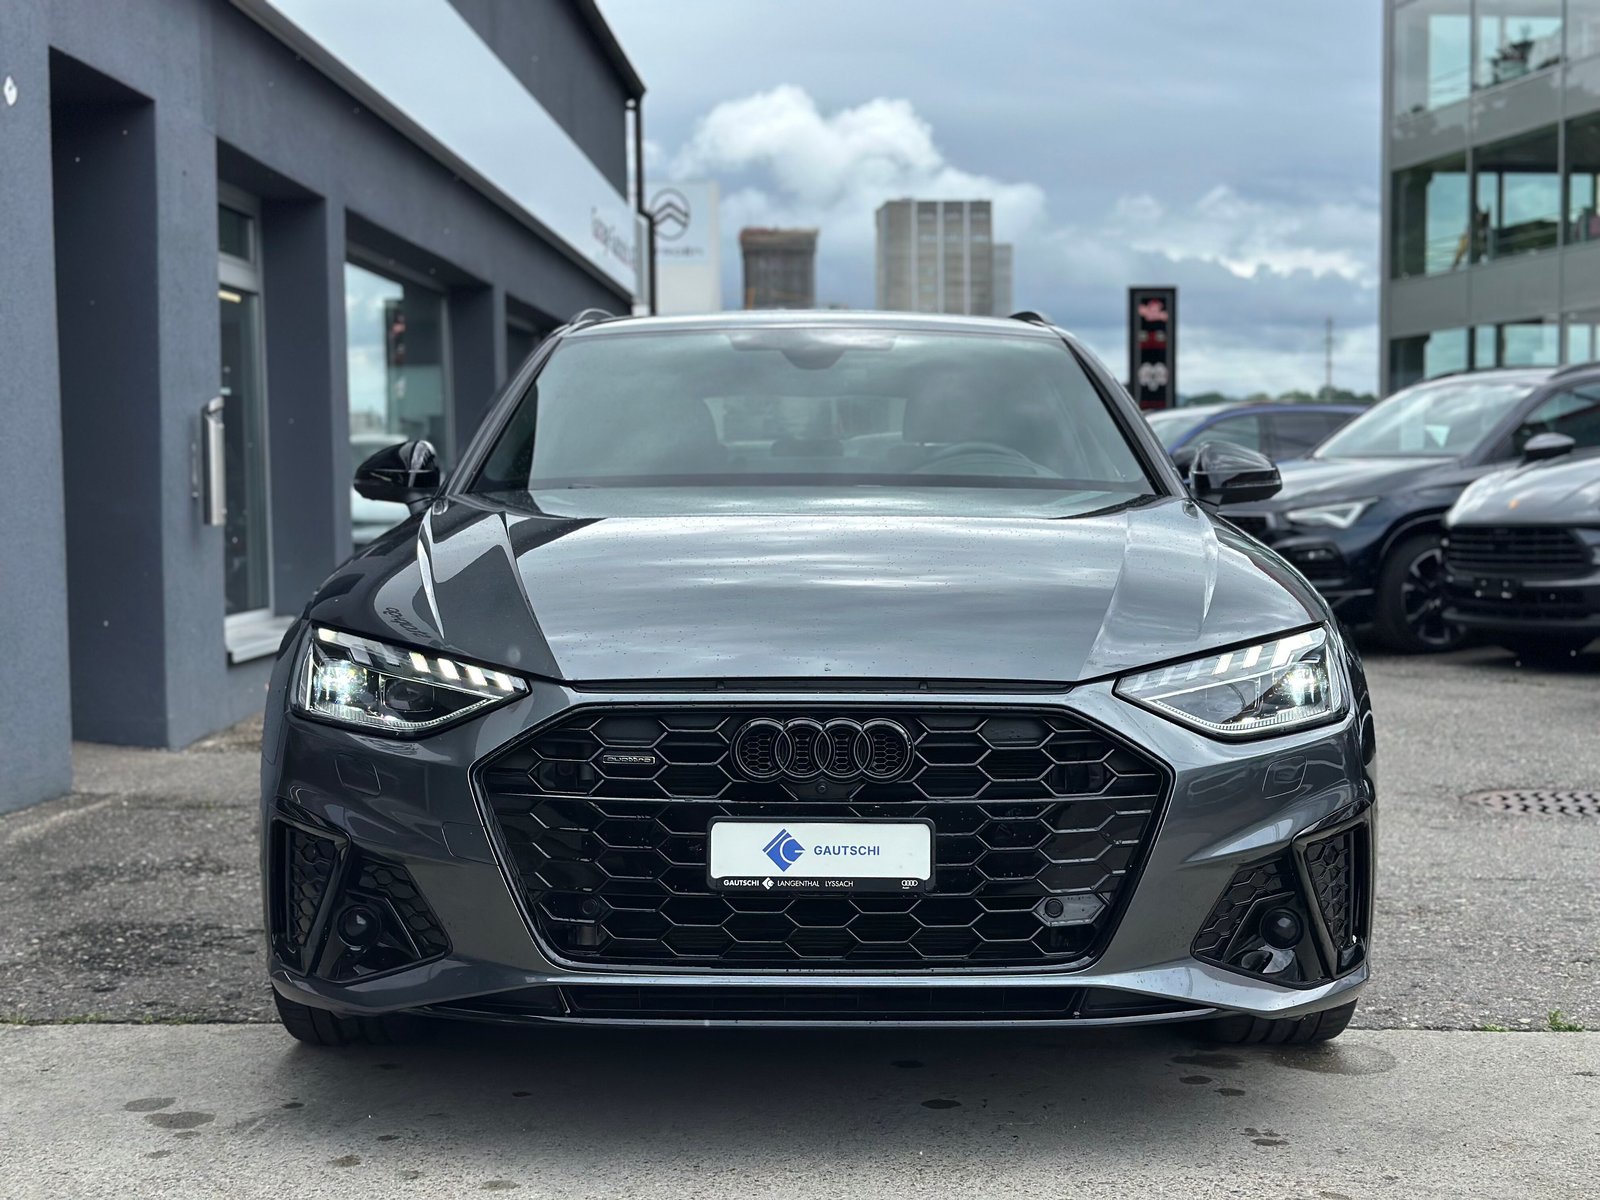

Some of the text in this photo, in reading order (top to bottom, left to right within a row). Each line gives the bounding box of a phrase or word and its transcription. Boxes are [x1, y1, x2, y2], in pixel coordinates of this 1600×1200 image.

[813, 845, 880, 856] GAUTSCHI
[723, 879, 854, 888] GAUTSCHI LANGENTHAL LYSSACH
